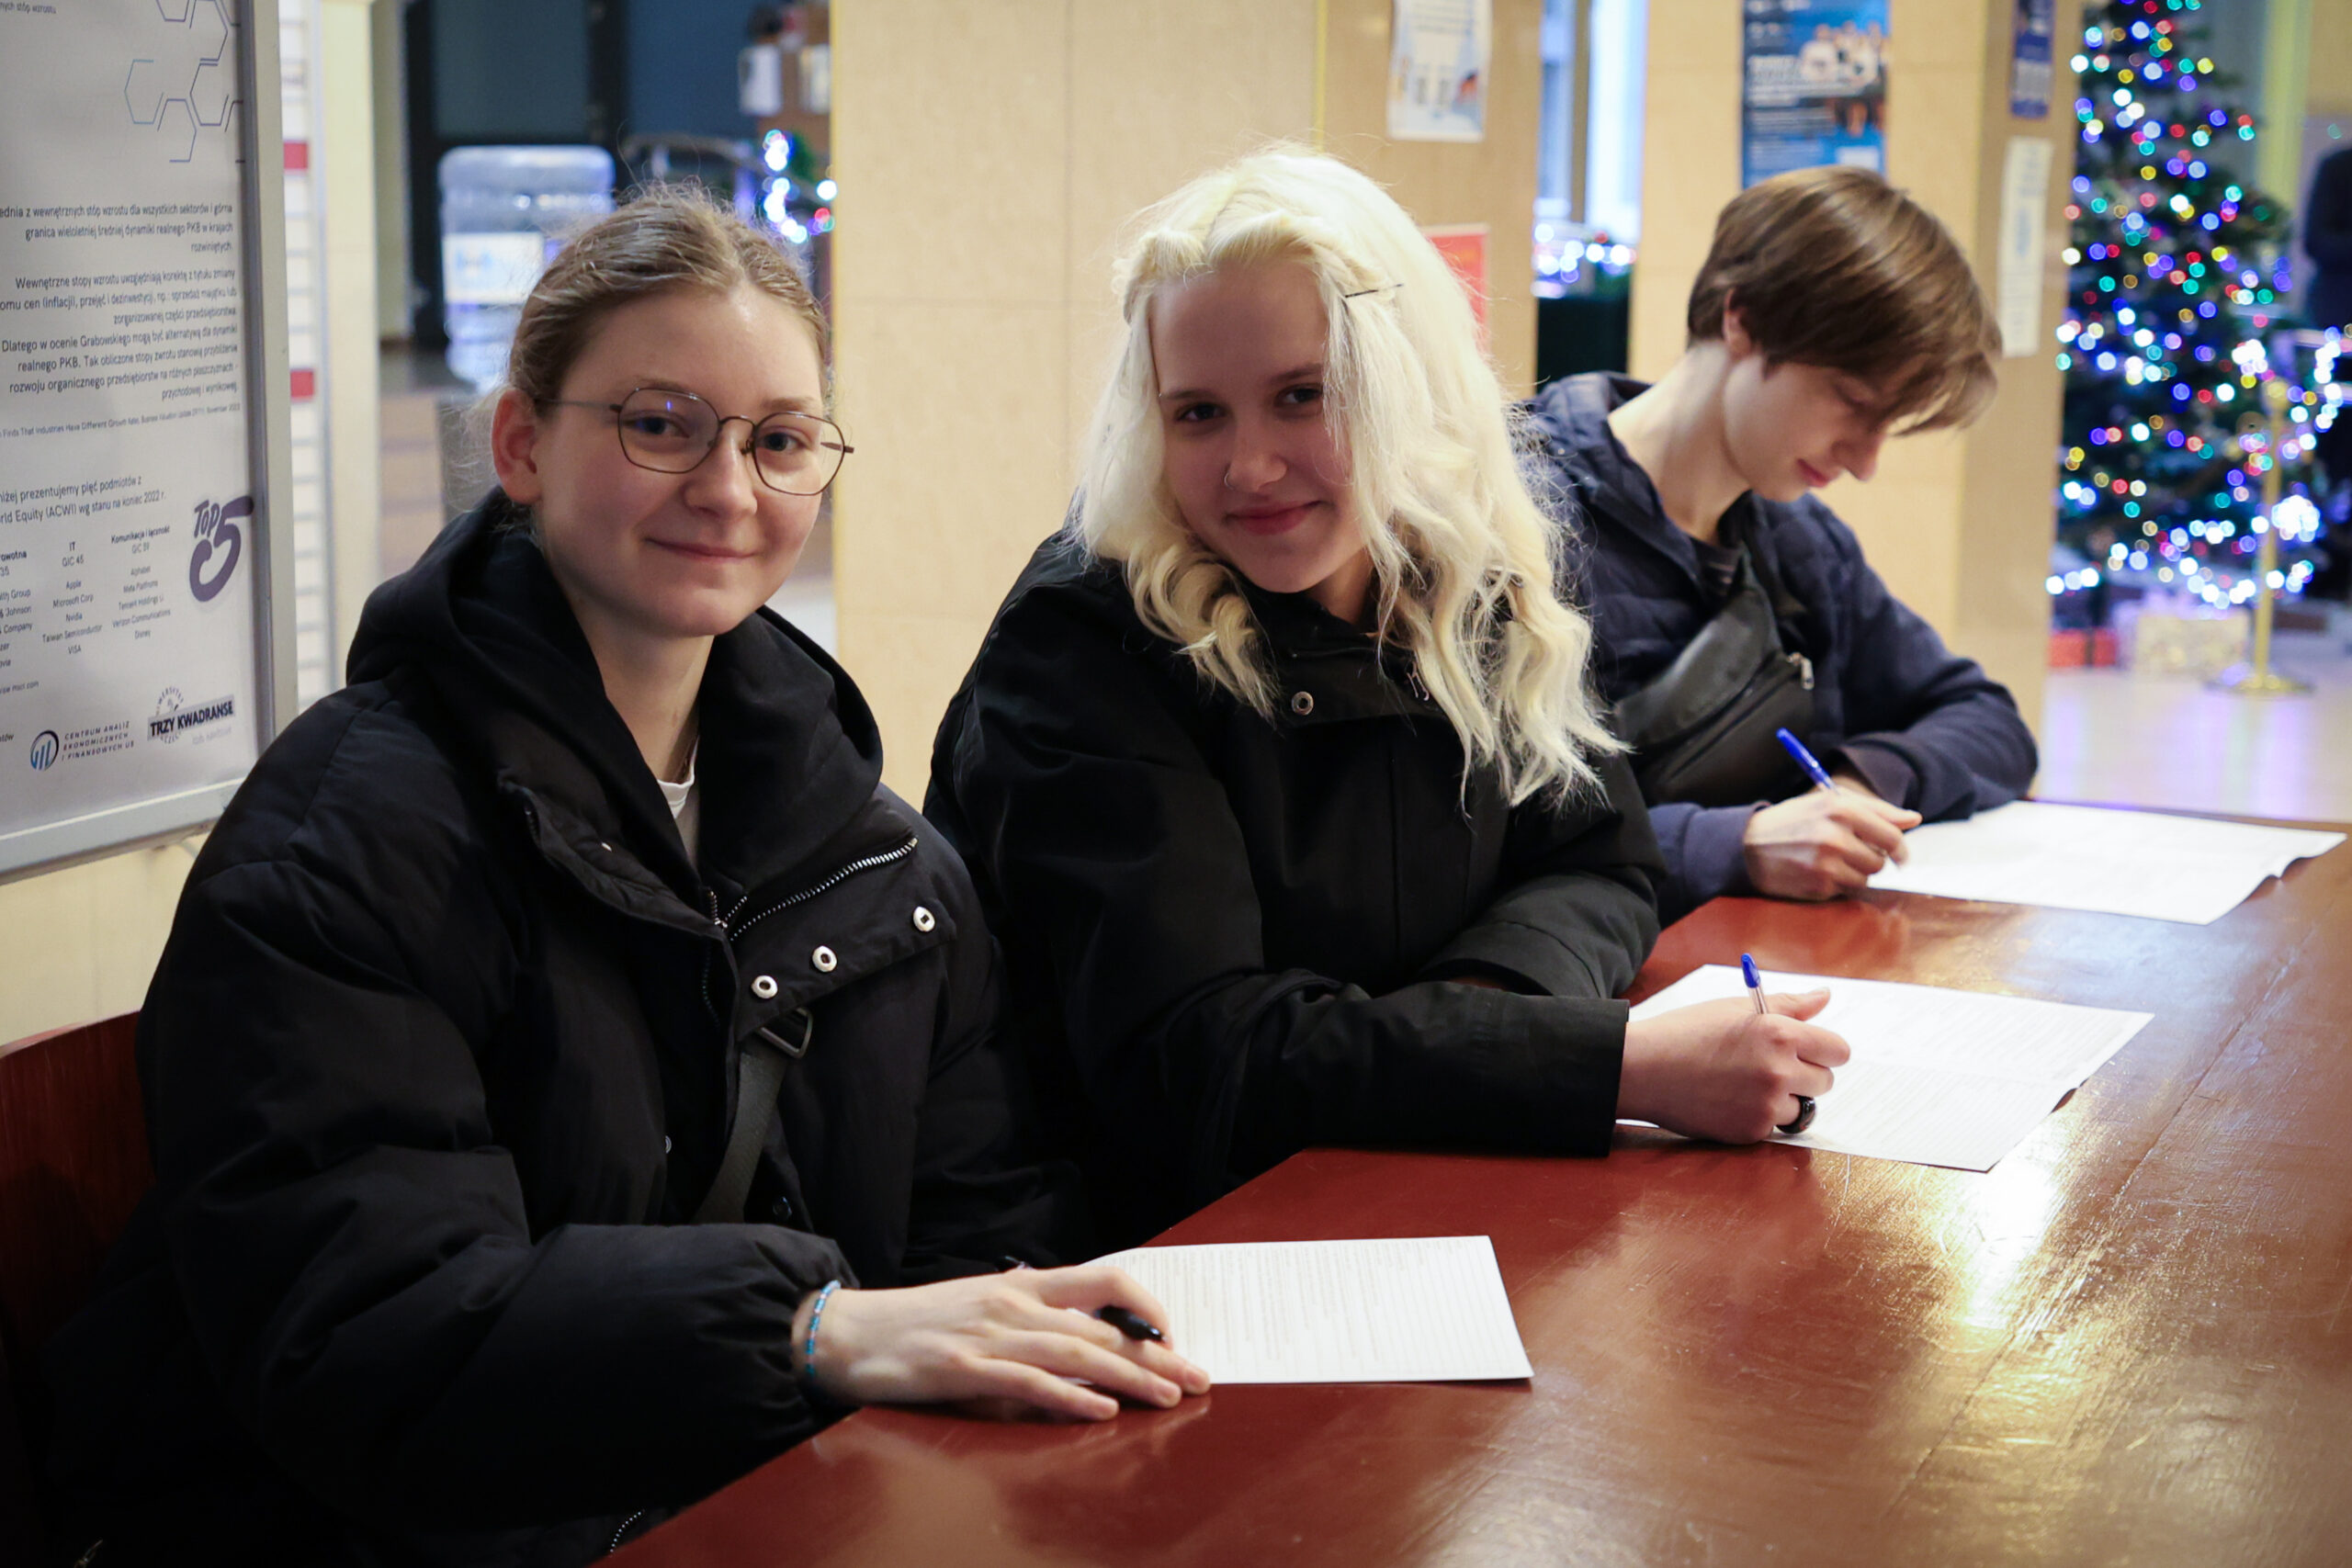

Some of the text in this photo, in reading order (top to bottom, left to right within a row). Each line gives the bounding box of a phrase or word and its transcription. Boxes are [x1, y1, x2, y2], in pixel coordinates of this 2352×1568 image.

[32, 206, 85, 220] wewnętrznych
[103, 205, 128, 217] wzrostu
[130, 204, 141, 216] dla
[142, 204, 178, 218] wszystkich
[25, 227, 56, 243] granica
[156, 223, 186, 237] realnego
[187, 221, 200, 233] PKB
[15, 276, 70, 290] Wewnętrzne
[72, 275, 92, 288] stopy
[93, 274, 119, 286] wzrostu
[24, 299, 40, 310] cen
[2, 339, 38, 354] Dlatego
[40, 341, 48, 350] w
[50, 336, 78, 350] ocenie
[80, 333, 130, 347] Grabowskiego
[132, 333, 152, 345] mogą
[17, 360, 57, 373] realnego
[59, 355, 82, 369] PKB.
[84, 355, 99, 367] Tak
[100, 355, 134, 366] obliczone
[135, 352, 153, 364] stopy
[9, 378, 45, 394] rozwoju
[48, 377, 105, 393] organicznego
[20, 484, 79, 502] prezentujemy
[81, 479, 98, 495] pięć
[99, 477, 137, 492] podmiotów
[15, 508, 43, 523] Equity
[45, 503, 77, 518] (ACWI)
[78, 502, 91, 516] wg
[92, 500, 111, 512] stanu
[112, 498, 121, 508] na
[121, 493, 142, 507] koniec
[143, 489, 160, 503] 2022
[189, 495, 254, 603] 5
[62, 556, 74, 567] GIC
[66, 580, 82, 591] Apple
[11, 589, 31, 600] Group
[52, 595, 79, 609] Microsoft
[6, 605, 32, 617] Johnson
[4, 623, 33, 634] Company
[42, 632, 63, 643] Taiwan
[68, 644, 82, 655] VISA
[150, 716, 175, 739] TRZY
[177, 700, 234, 730] KWADRANSE
[64, 720, 130, 740] CENTRUM ANALIZ
[63, 732, 129, 751] EKONOMICZNYCH
[67, 743, 123, 761] FINANSOWYCH
